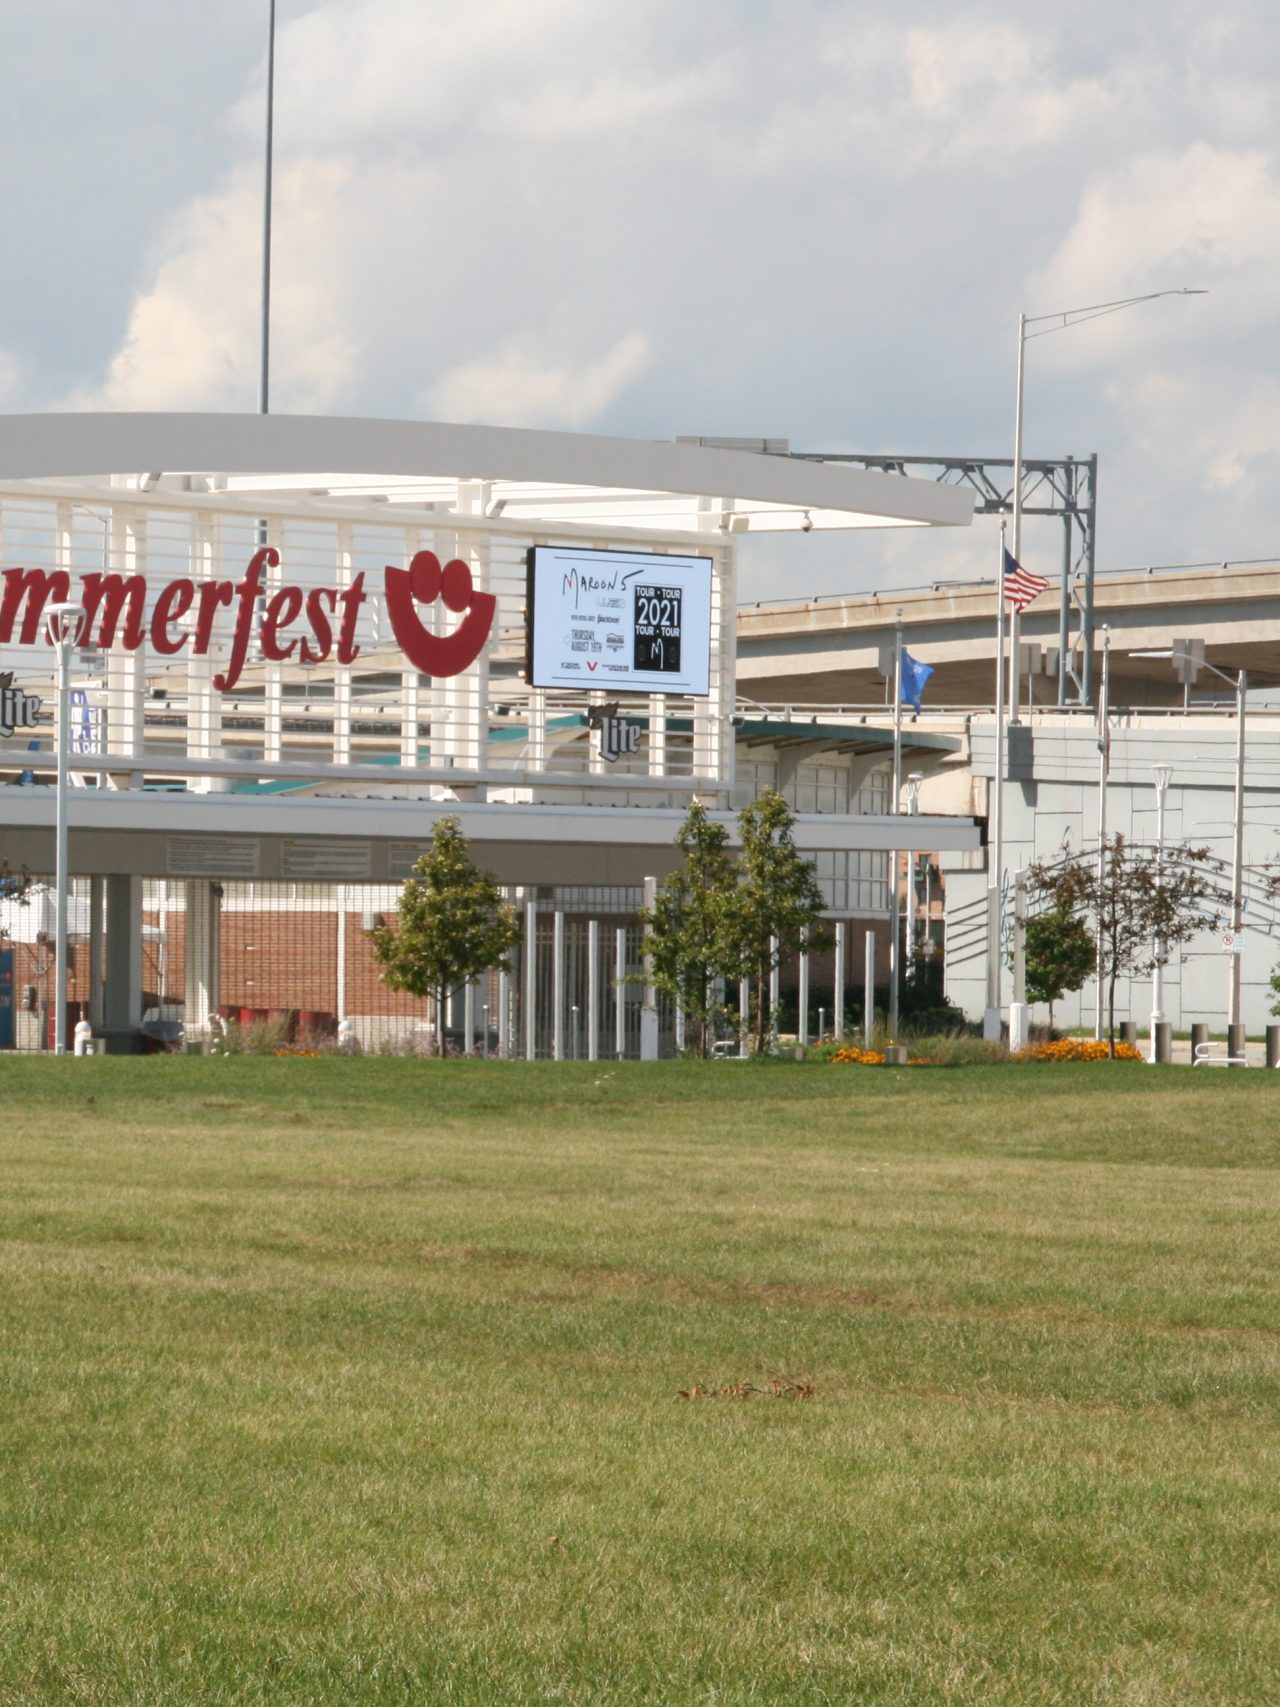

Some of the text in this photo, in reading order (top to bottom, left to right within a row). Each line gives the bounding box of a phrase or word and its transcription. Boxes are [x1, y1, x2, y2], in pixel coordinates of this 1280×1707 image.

[621, 569, 644, 591] 5
[636, 587, 681, 599] TOUR TOUR
[637, 598, 678, 626] 2021
[635, 625, 680, 637] TOUR TOUR
